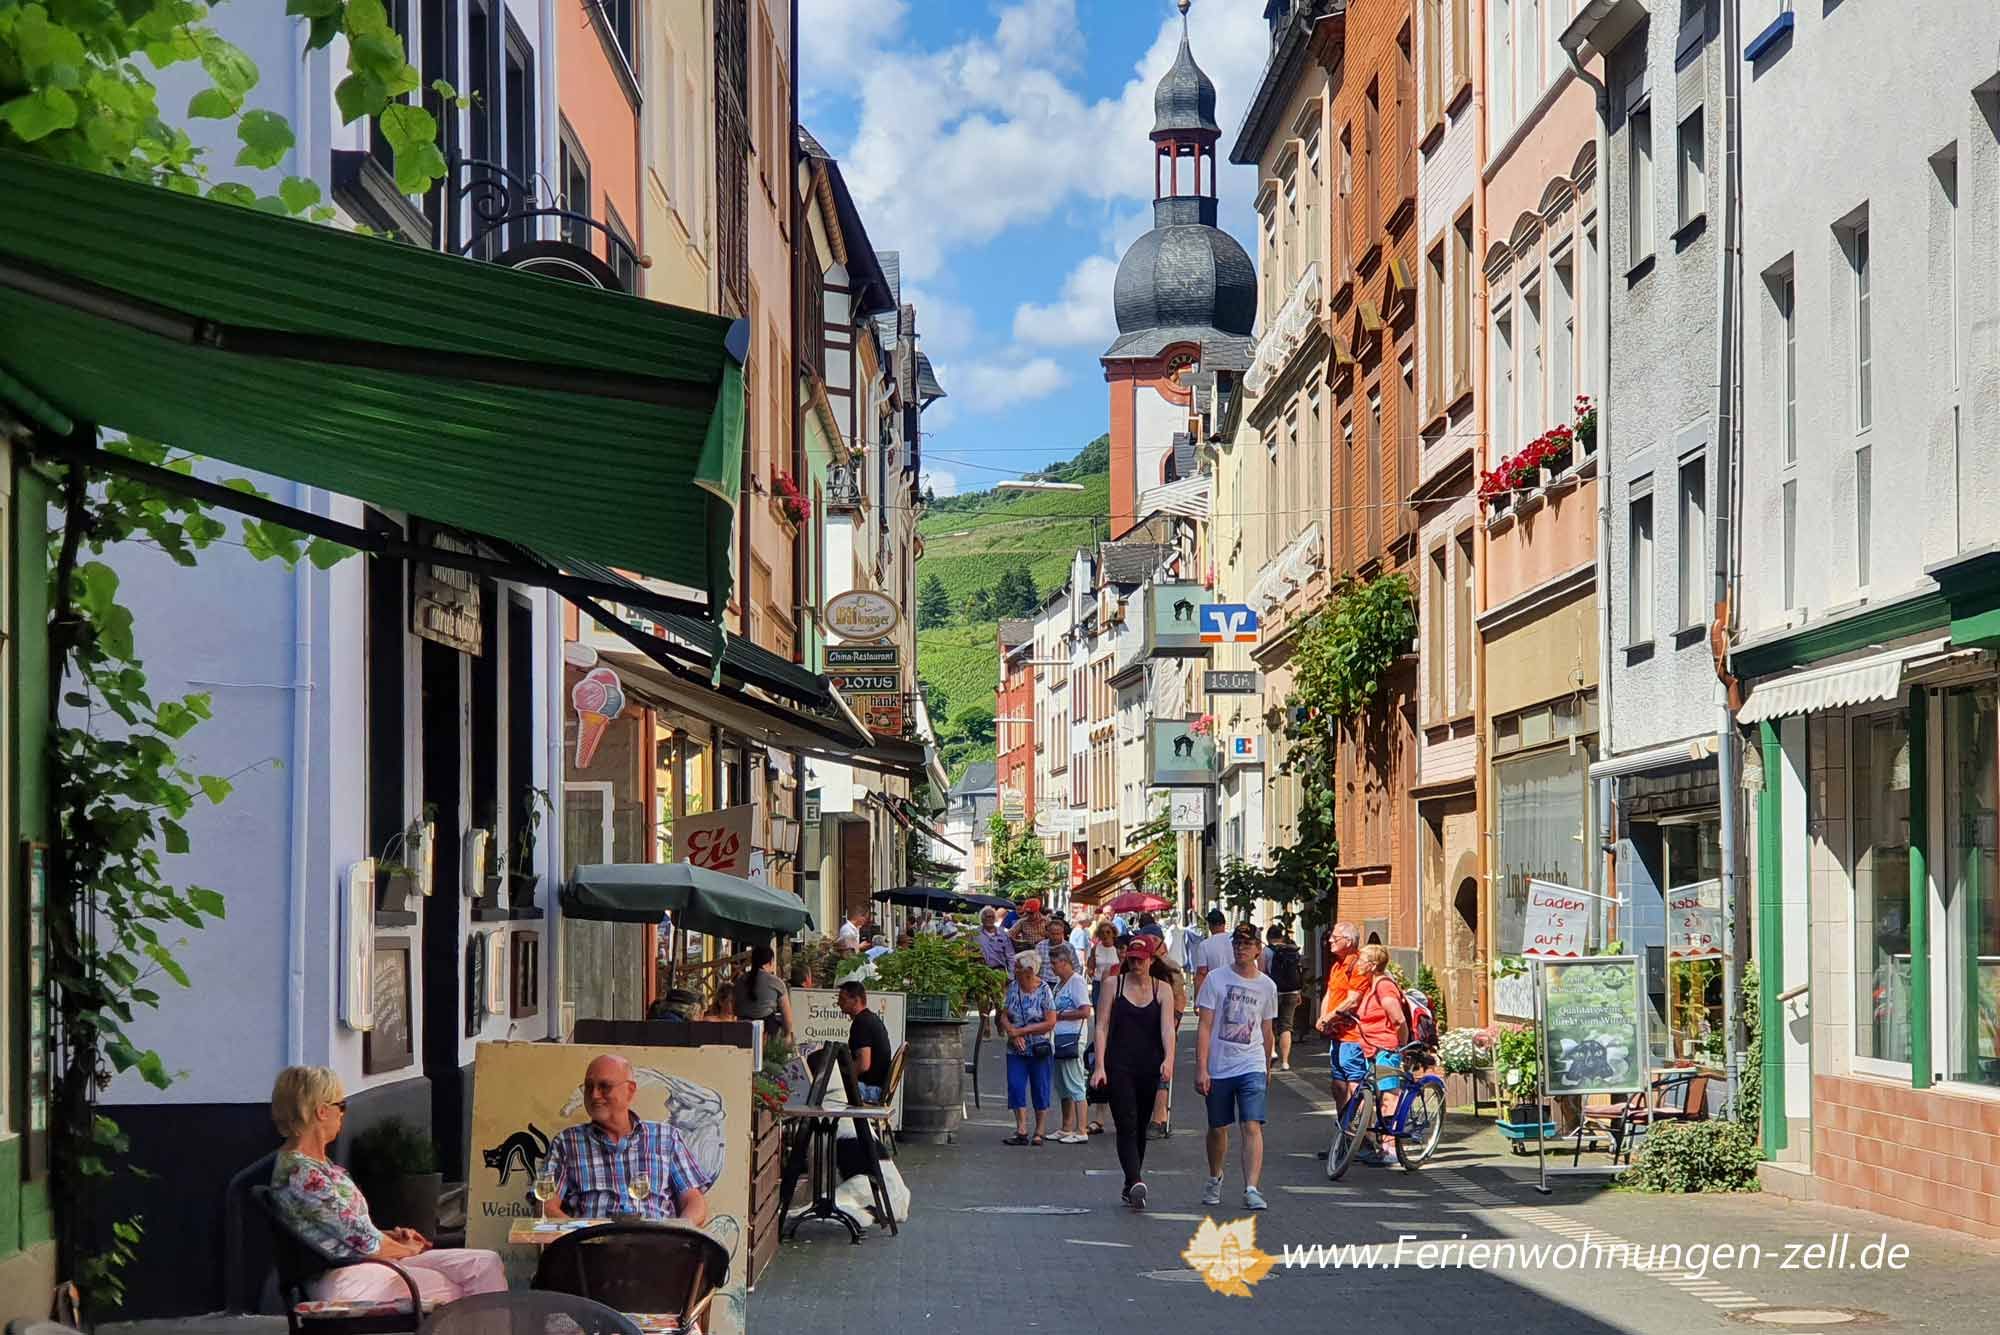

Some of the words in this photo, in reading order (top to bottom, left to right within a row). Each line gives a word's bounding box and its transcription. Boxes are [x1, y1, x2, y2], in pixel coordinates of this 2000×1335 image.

[845, 676, 893, 689] LOTUS
[687, 826, 740, 868] Eis
[1533, 893, 1585, 911] Laden
[1534, 932, 1563, 945] auf
